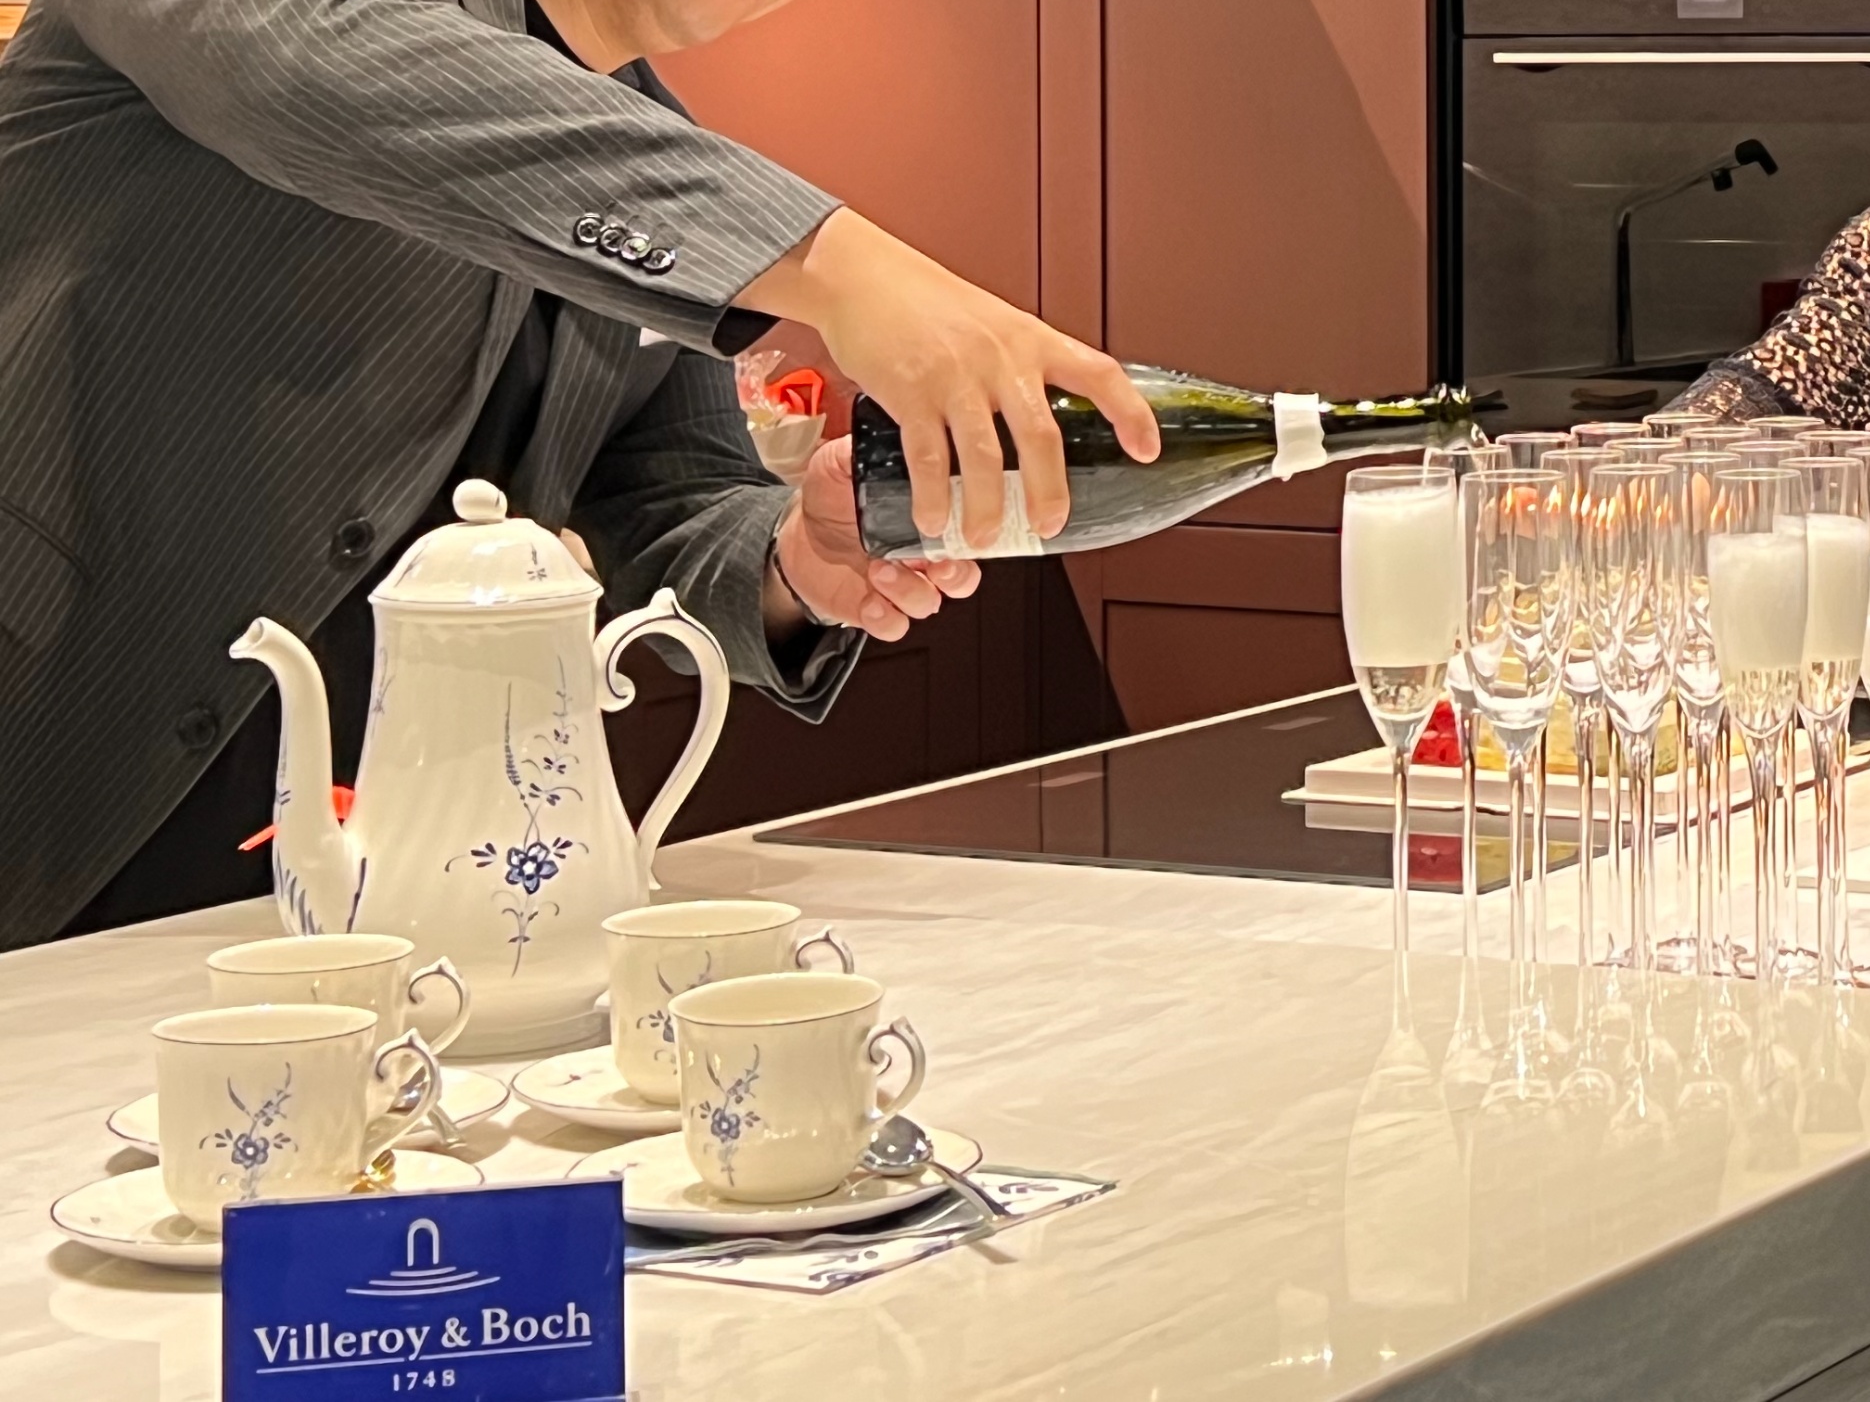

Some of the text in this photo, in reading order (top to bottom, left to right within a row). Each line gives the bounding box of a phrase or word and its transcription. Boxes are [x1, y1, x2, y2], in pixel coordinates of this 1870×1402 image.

[253, 1302, 592, 1363] Villeroy & Boch
[392, 1369, 456, 1391] 1748
